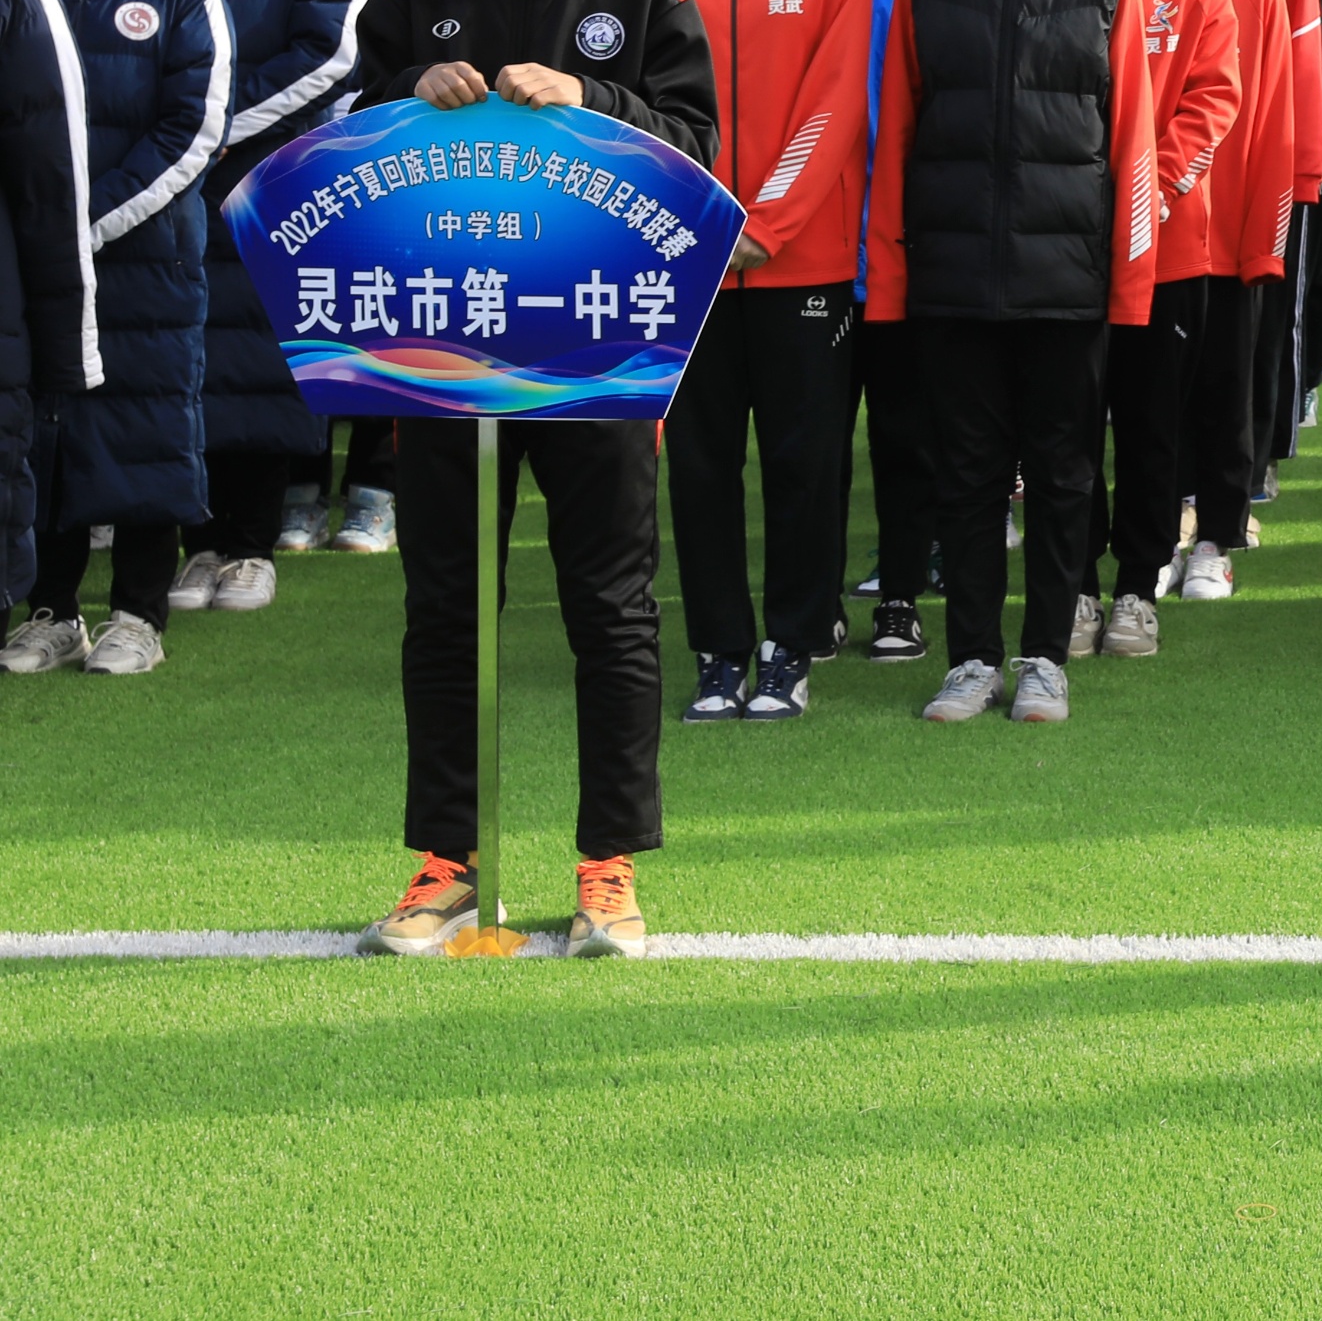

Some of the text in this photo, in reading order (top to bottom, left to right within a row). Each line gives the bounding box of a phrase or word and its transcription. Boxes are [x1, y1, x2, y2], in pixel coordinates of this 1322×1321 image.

[269, 140, 698, 262] 2022年宁夏回族自治区青少年校园足球联赛
[294, 266, 677, 341] 灵武市第一中学
